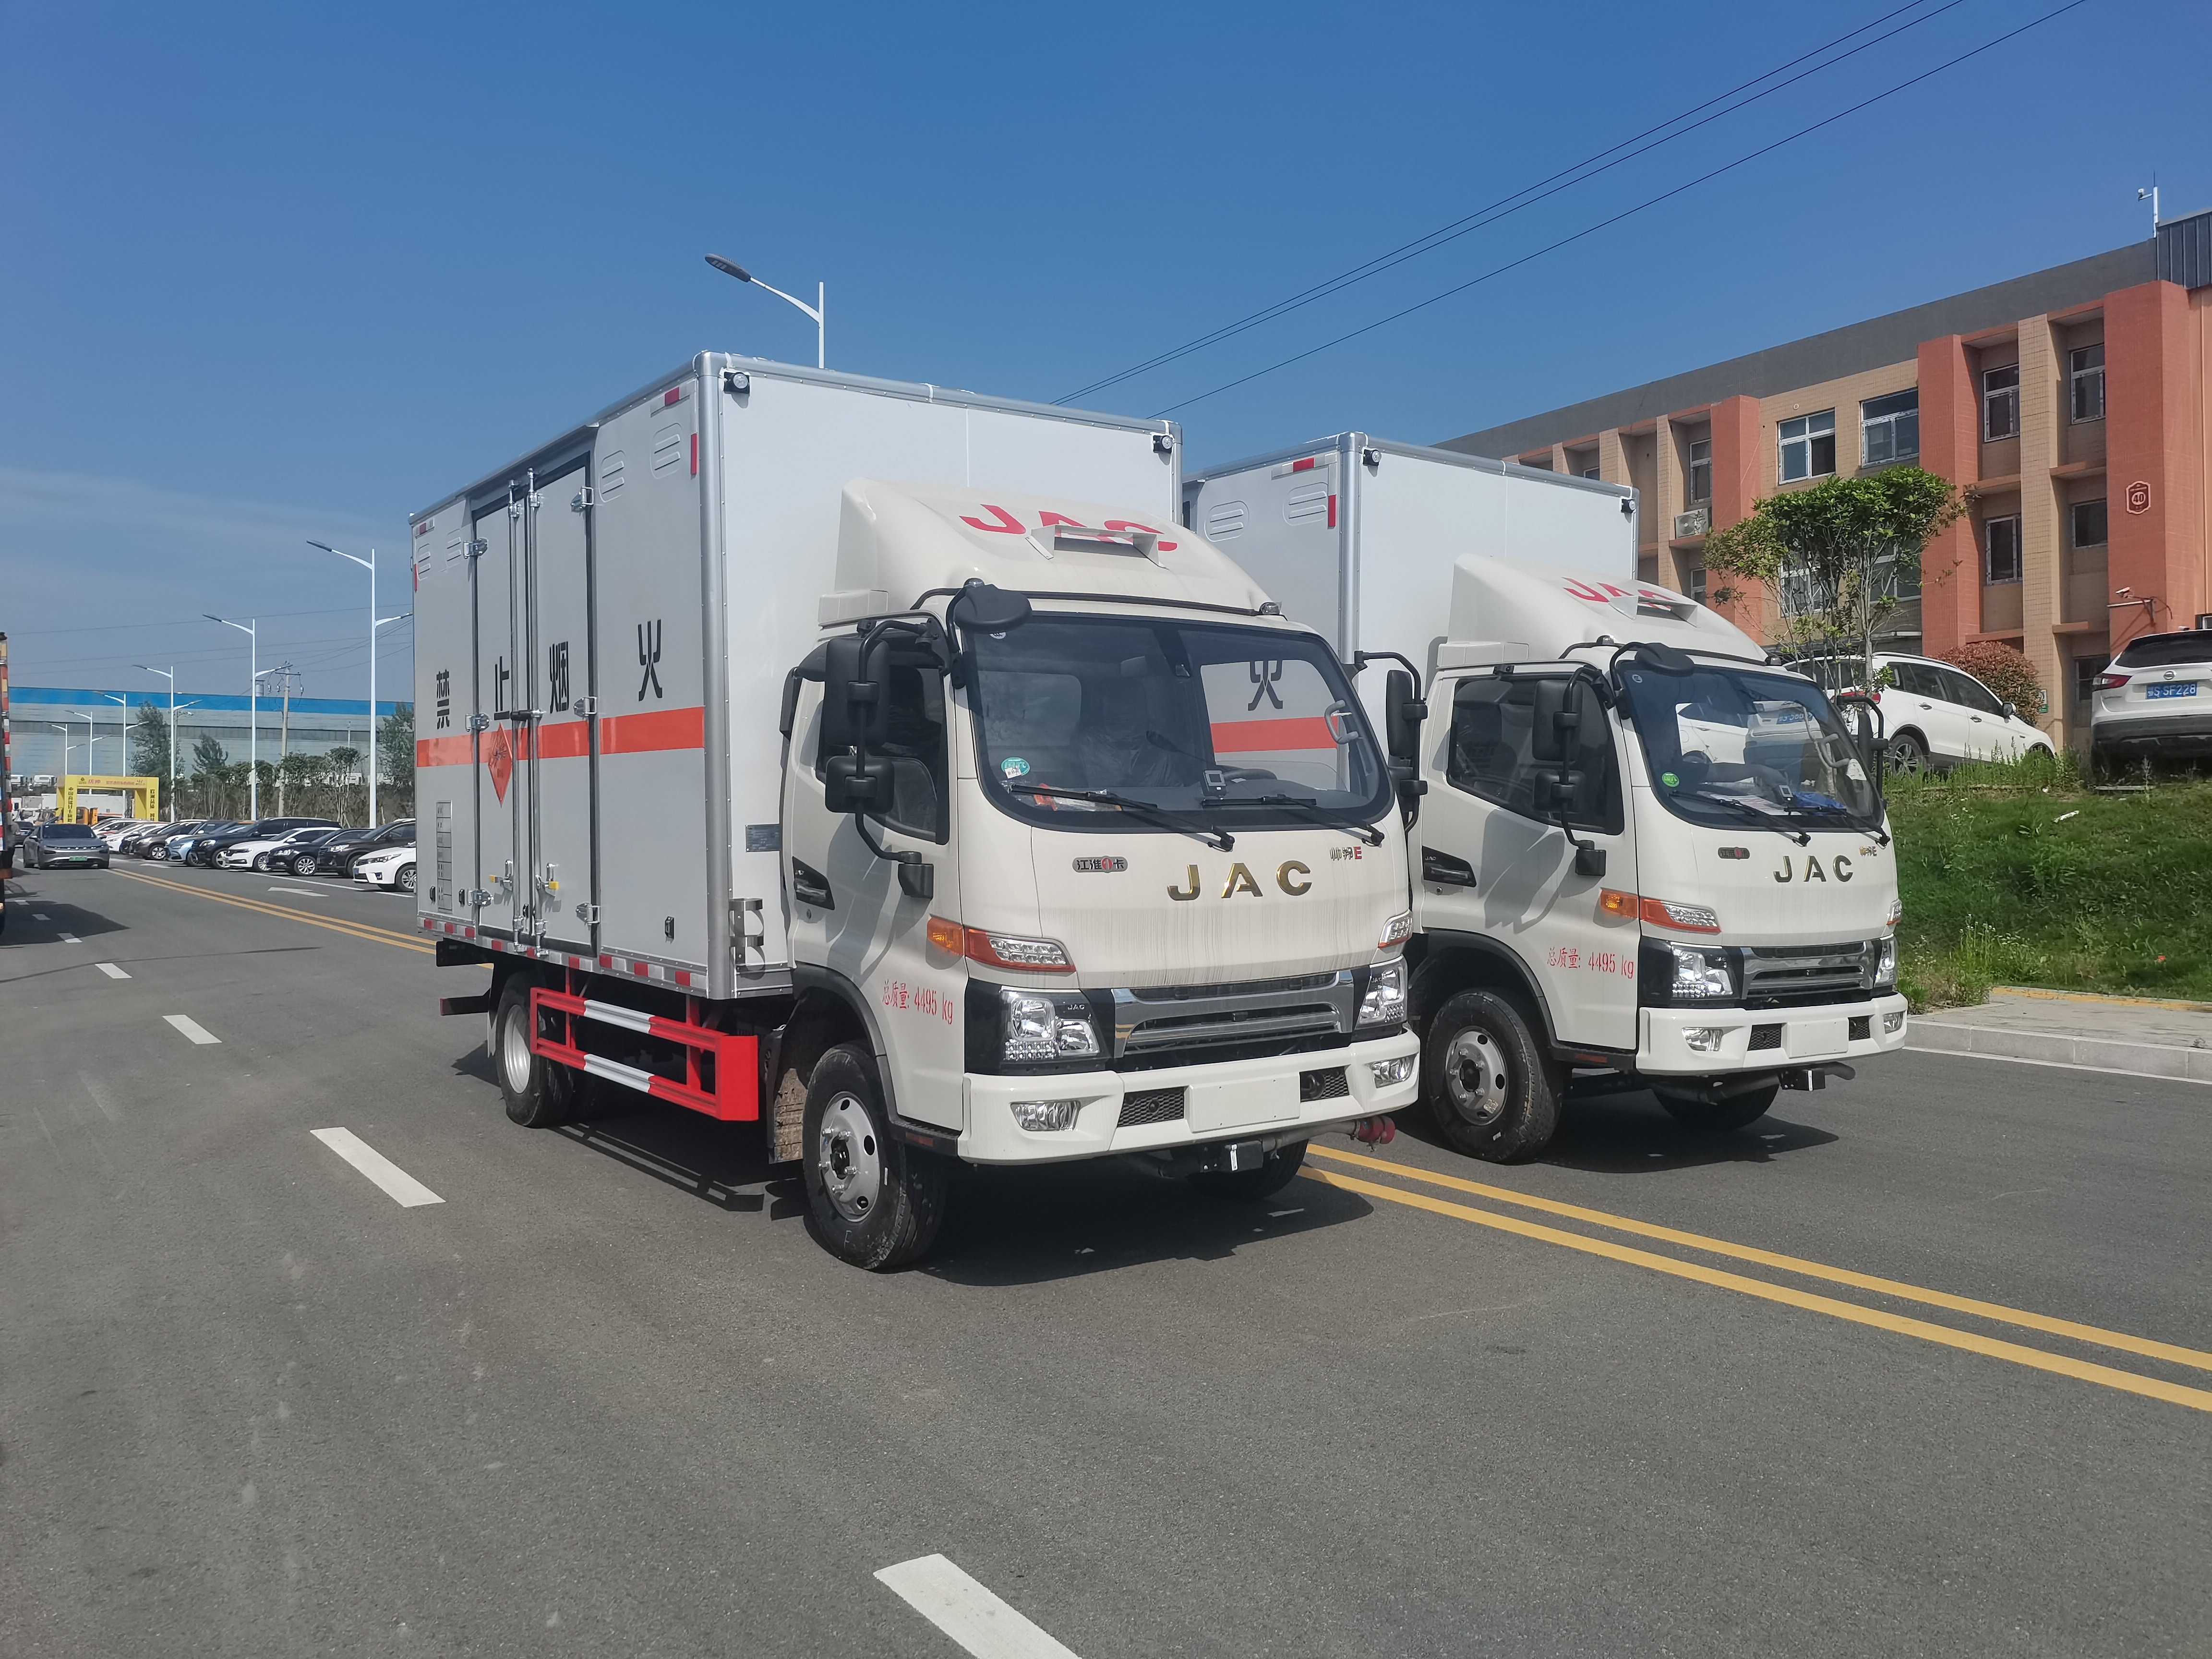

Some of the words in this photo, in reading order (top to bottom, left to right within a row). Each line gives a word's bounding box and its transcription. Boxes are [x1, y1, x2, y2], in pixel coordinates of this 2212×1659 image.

[2133, 494, 2144, 503] 40
[436, 619, 663, 730] 禁止烟火
[1166, 860, 1312, 901] JAC
[1773, 855, 1853, 883] JAC
[1588, 951, 1615, 974] 4495
[1621, 954, 1634, 979] kg
[914, 986, 937, 1015] 4495
[942, 991, 953, 1025] kg
